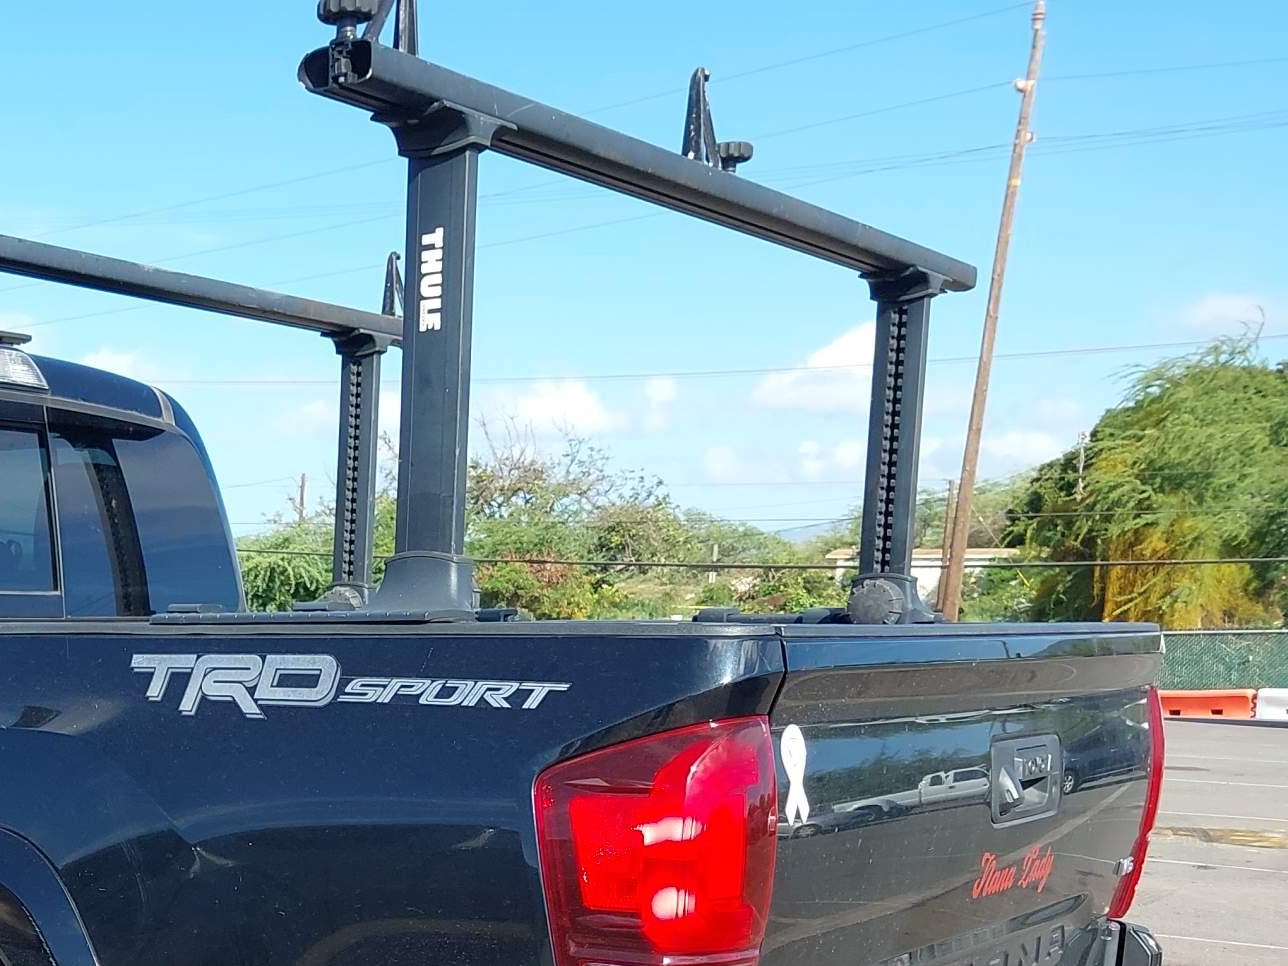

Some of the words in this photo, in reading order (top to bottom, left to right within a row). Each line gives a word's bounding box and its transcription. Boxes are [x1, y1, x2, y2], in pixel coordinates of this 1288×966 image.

[418, 226, 444, 332] THULE
[130, 652, 342, 719] TRD
[337, 676, 572, 710] SPORT
[1017, 845, 1055, 893] Lady
